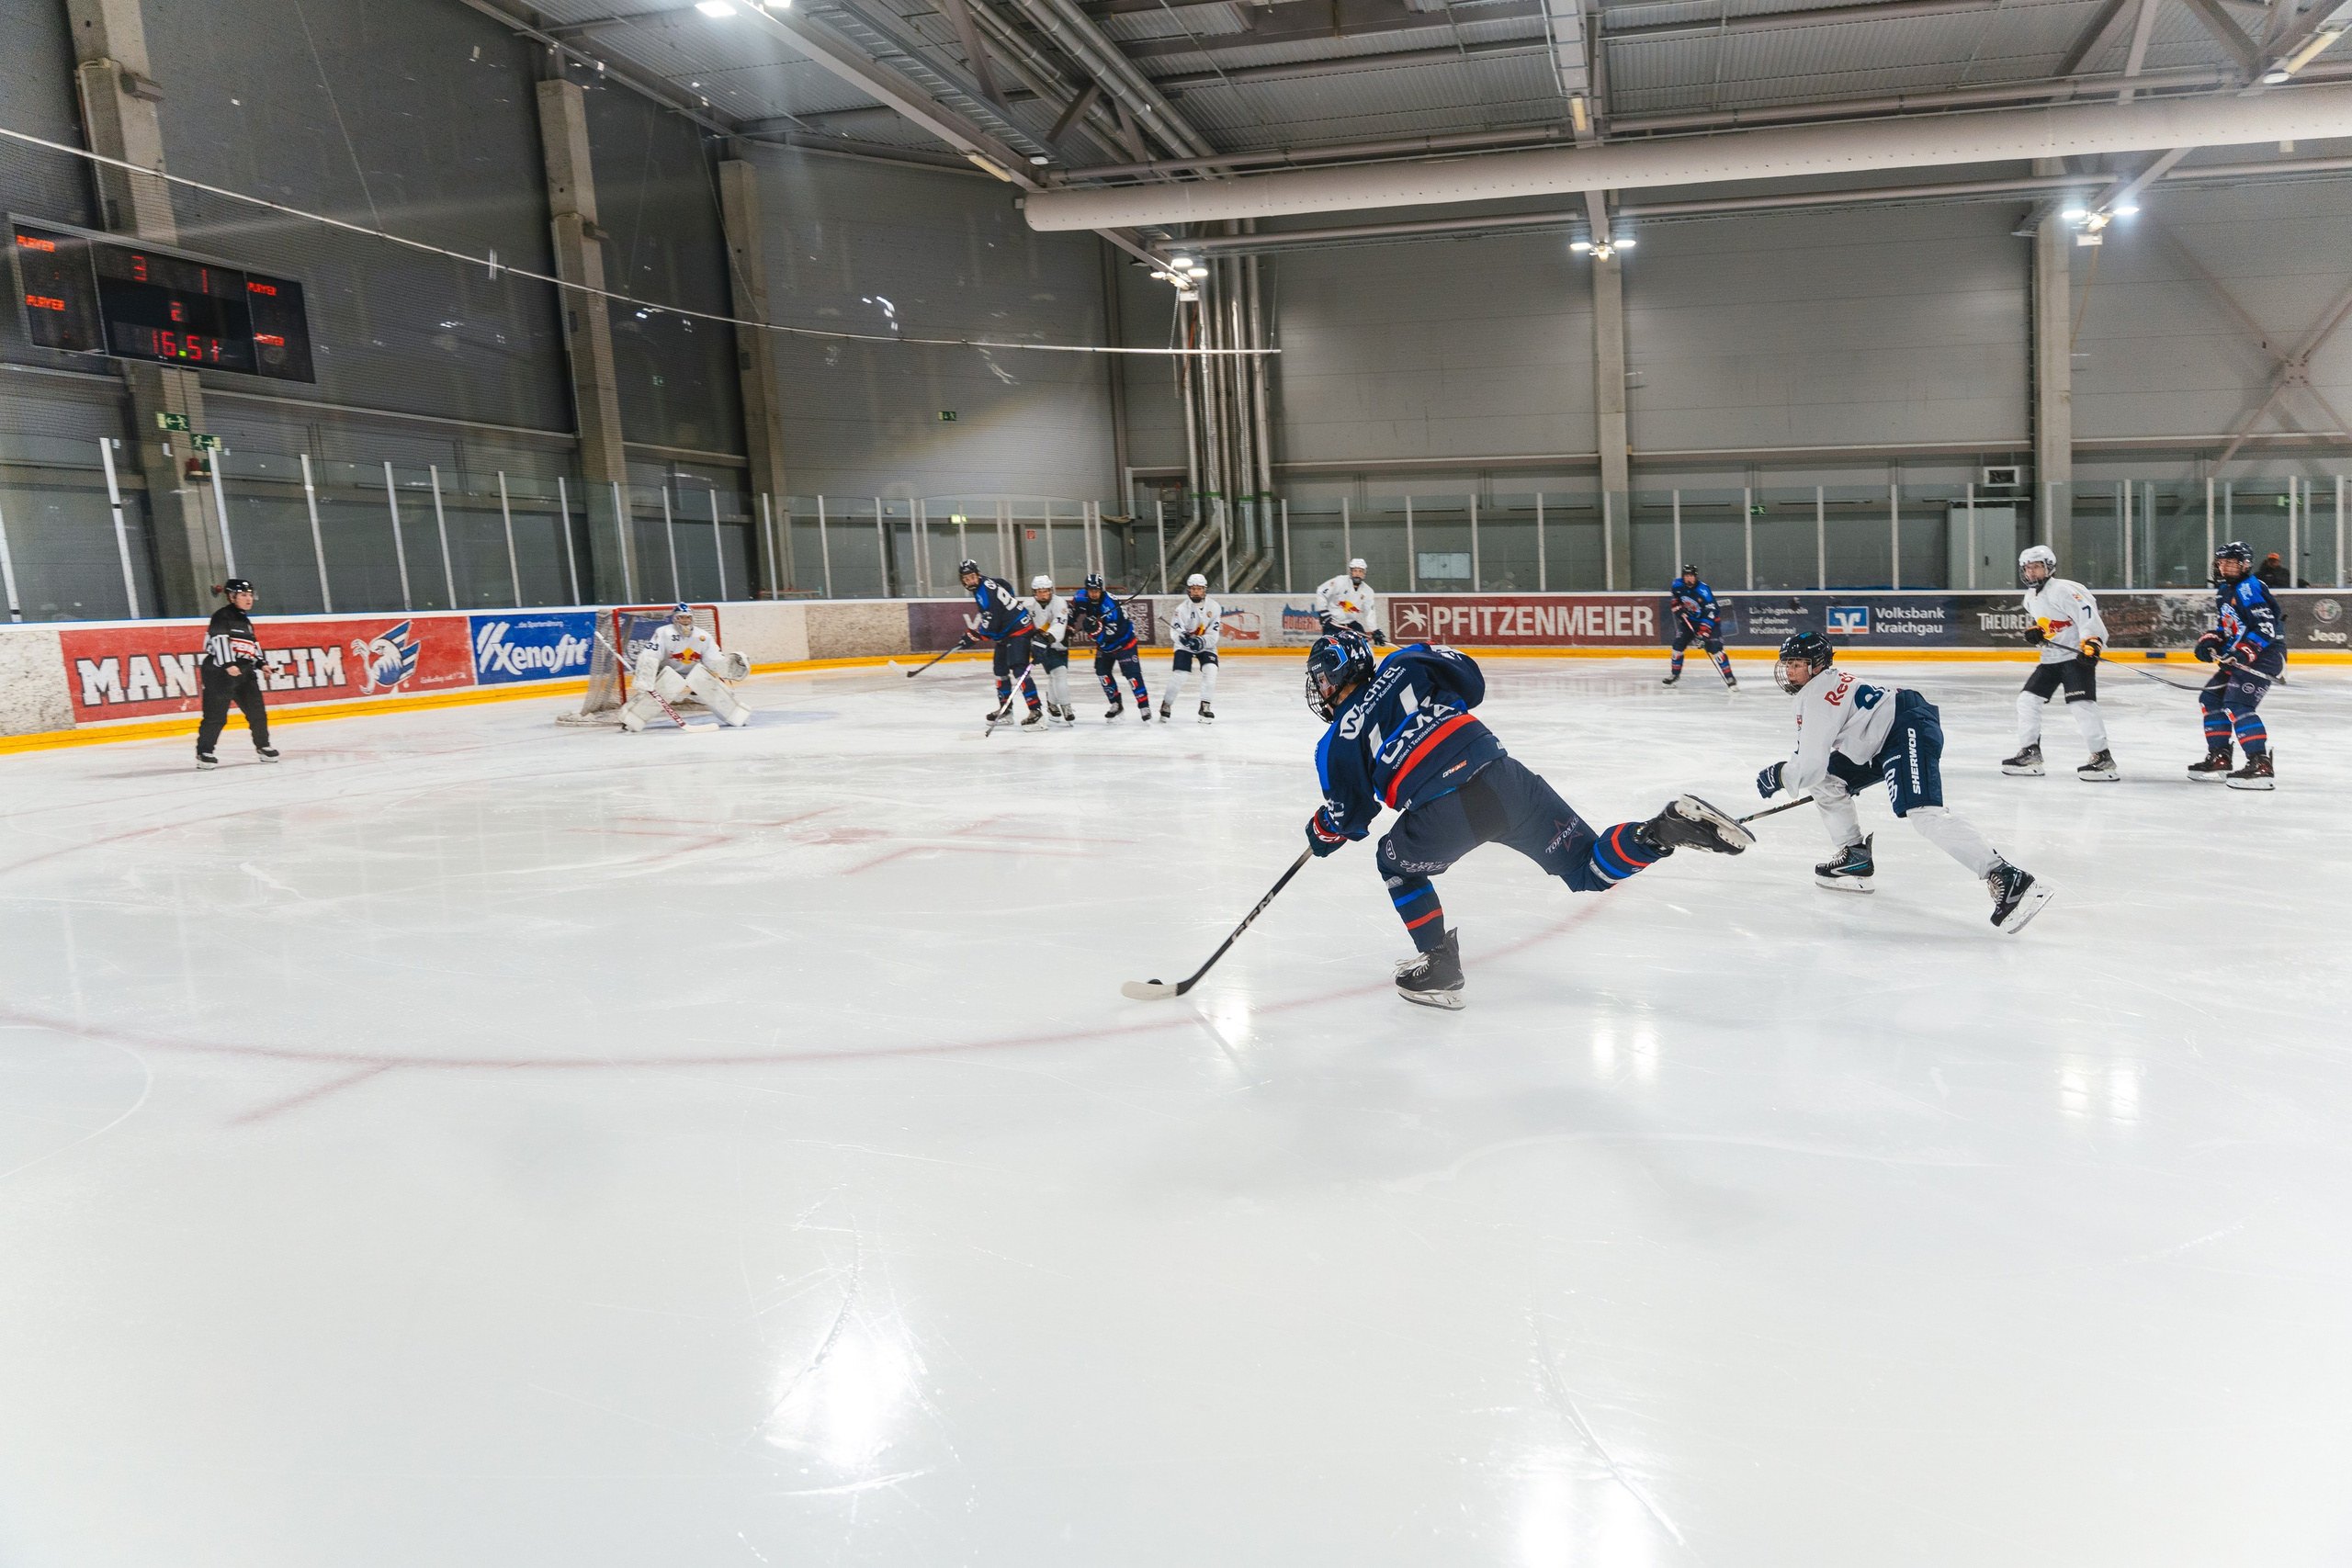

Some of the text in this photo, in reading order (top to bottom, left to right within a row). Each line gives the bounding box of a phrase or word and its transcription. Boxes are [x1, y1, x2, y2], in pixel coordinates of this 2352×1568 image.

[131, 255, 147, 281] 3
[201, 269, 209, 293] 1
[26, 294, 65, 310] PLAYER
[171, 301, 182, 321] 2
[1875, 607, 1945, 620] Volksbank
[2082, 605, 2091, 618] 7
[1432, 606, 1654, 637] PFITZENMEIER
[1876, 622, 1943, 636] Kraichgau
[2308, 629, 2347, 644] Jeep
[477, 621, 589, 676] Xenofit
[1351, 645, 1366, 660] 44
[1379, 682, 1392, 698] Kanal
[1391, 667, 1407, 684] GmbH
[1392, 746, 1410, 771] Textilien
[1410, 722, 1437, 748] Textilstick
[1544, 838, 1563, 853] TOP
